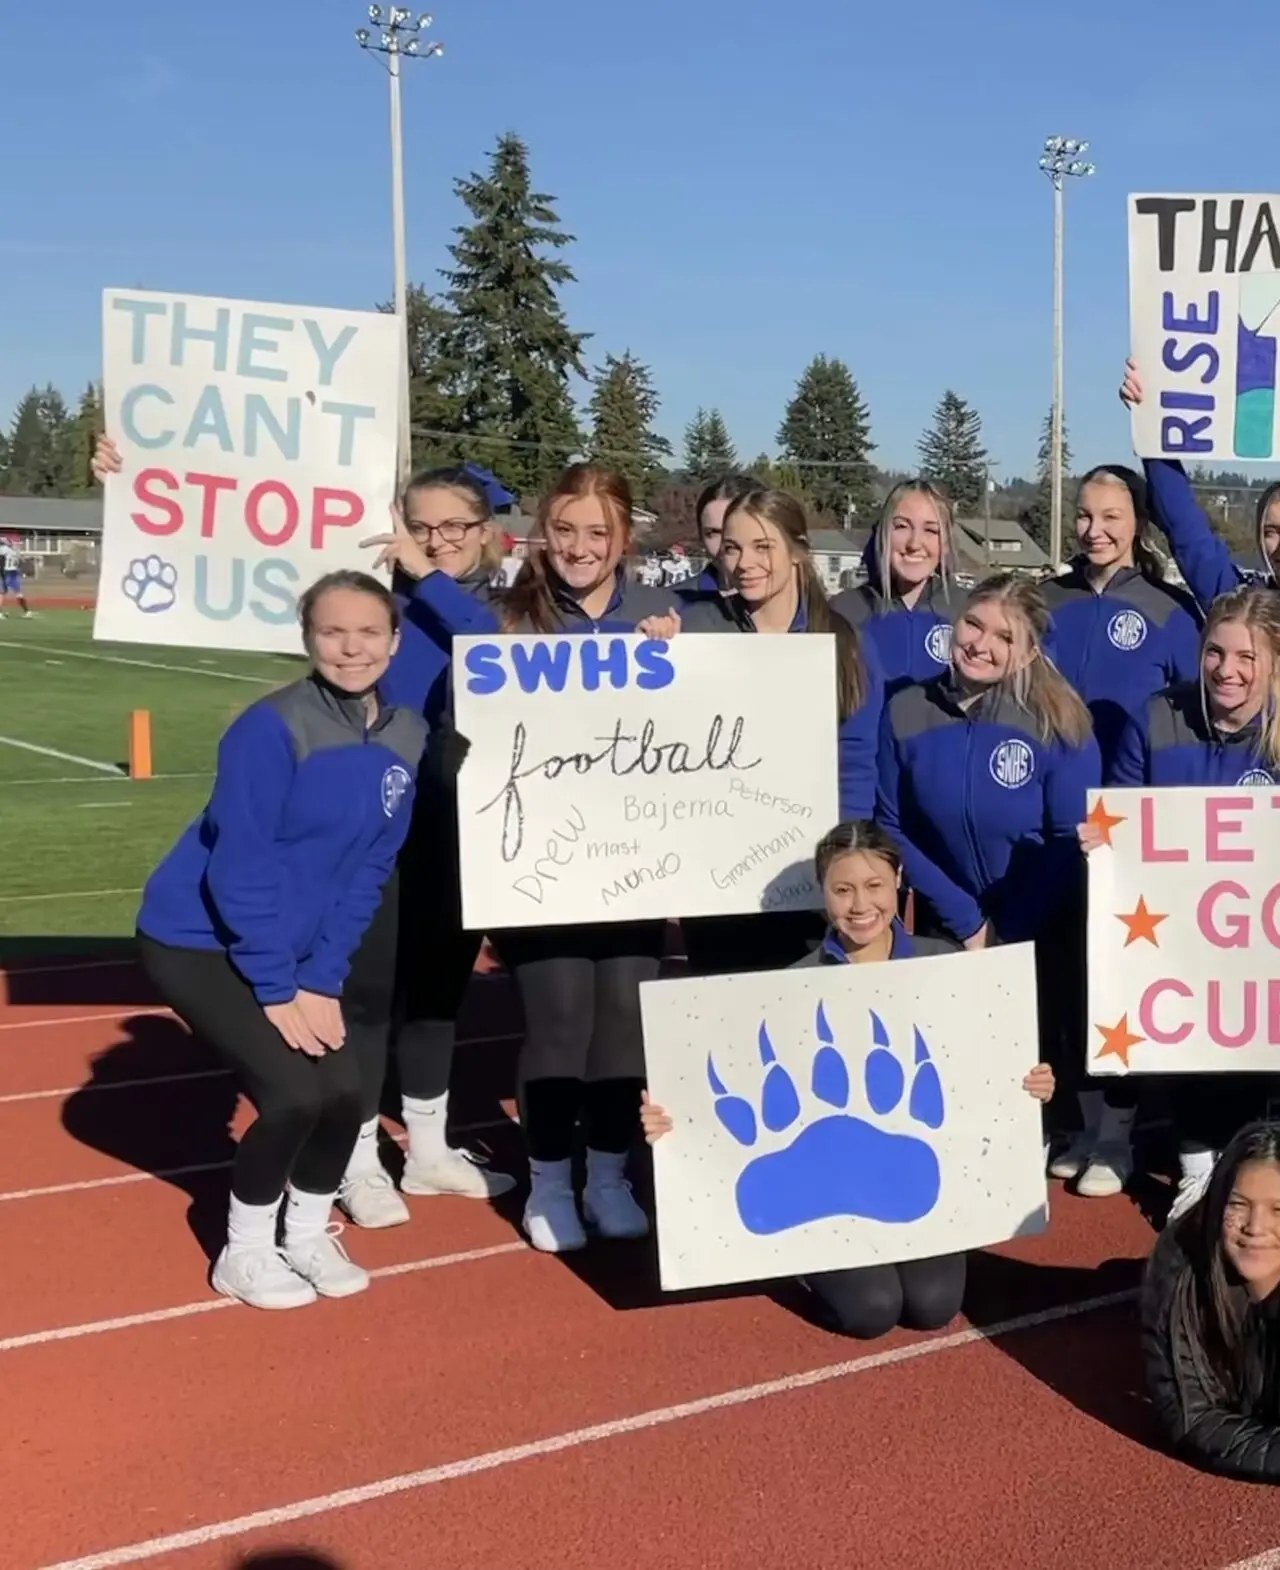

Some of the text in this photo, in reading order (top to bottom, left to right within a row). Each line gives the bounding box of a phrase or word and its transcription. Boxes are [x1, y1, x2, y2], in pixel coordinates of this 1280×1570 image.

[112, 298, 359, 386] THEY
[1160, 290, 1220, 453] RISE
[120, 384, 376, 466] CAN'T
[130, 468, 365, 550] STOP
[193, 554, 299, 626] US
[464, 638, 676, 695] SWHS
[475, 713, 762, 862] football
